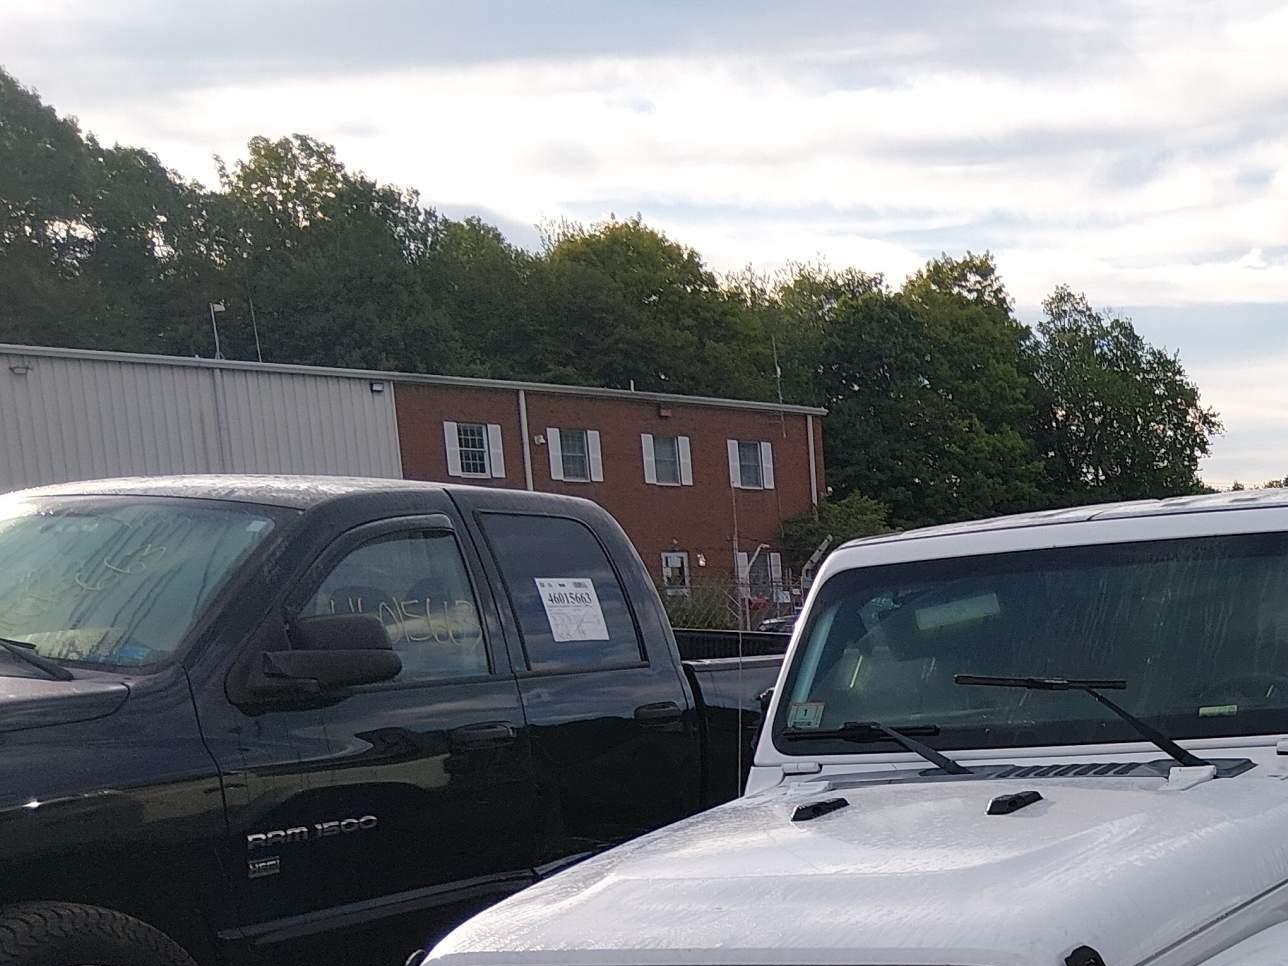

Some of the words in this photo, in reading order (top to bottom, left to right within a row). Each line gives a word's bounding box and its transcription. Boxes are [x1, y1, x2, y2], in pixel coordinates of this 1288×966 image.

[547, 592, 593, 605] 46015663
[247, 826, 309, 849] RAM
[315, 815, 378, 838] 1500
